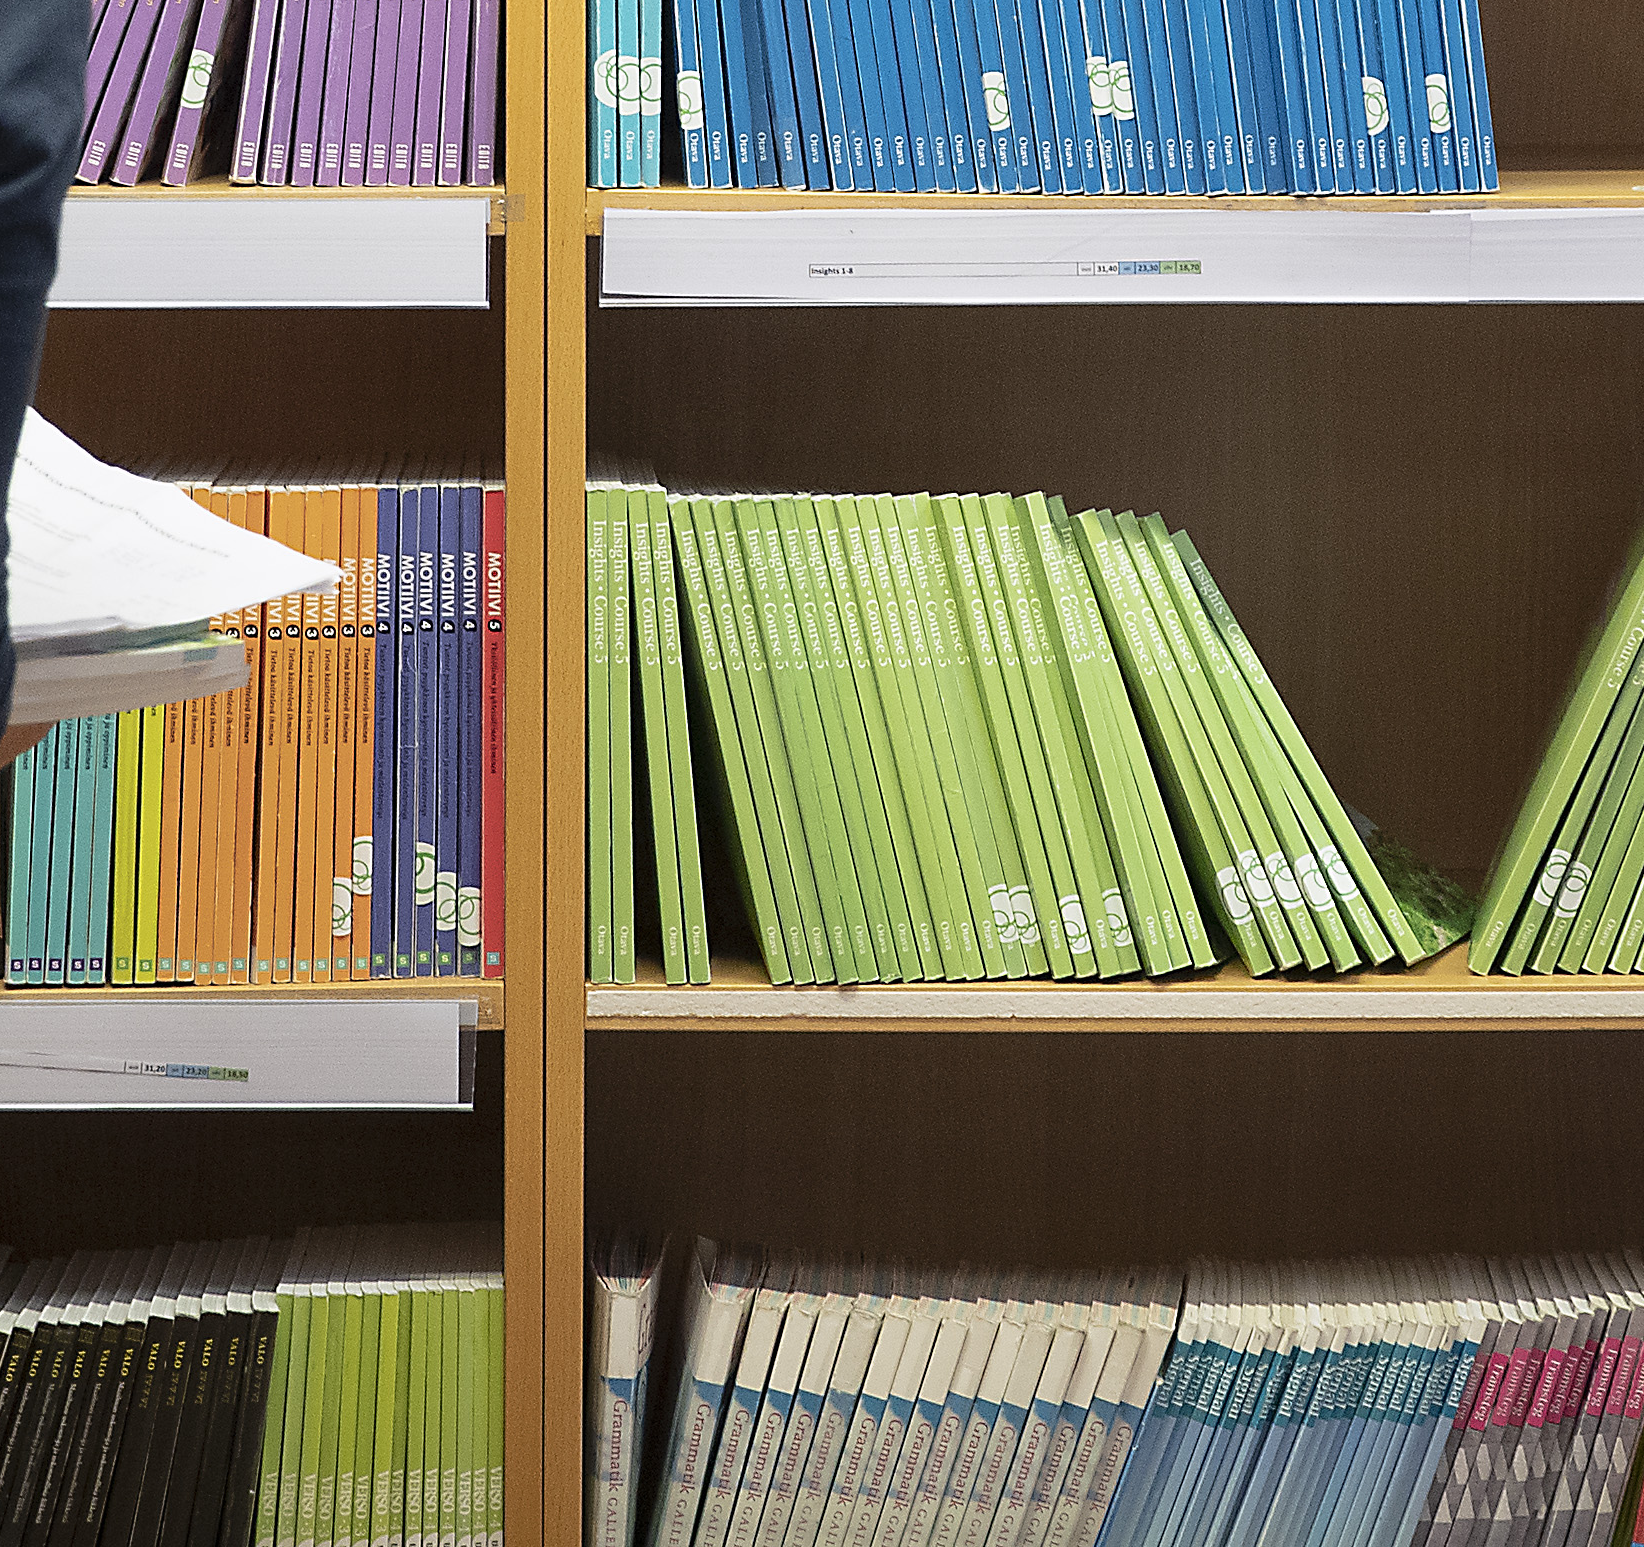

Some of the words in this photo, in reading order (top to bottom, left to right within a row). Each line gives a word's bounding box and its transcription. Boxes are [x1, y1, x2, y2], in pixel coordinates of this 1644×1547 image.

[1398, 136, 1406, 166] Otava
[1461, 137, 1469, 167] Otava
[811, 266, 840, 275] Insights
[1097, 264, 1117, 273] 31,40
[1138, 264, 1159, 272] 23,30
[1179, 263, 1200, 272] 18,70
[590, 521, 607, 582] Insights
[342, 557, 356, 621] MOTIIVI
[419, 552, 433, 616] MOTIIVI
[488, 552, 502, 616] MOTIIVI
[343, 626, 355, 635] 3
[421, 621, 431, 630] 4
[489, 622, 501, 630] 5
[594, 595, 607, 649] Course
[596, 654, 608, 663] 5
[144, 1065, 165, 1073] 31,20
[186, 1068, 207, 1076] 23,20
[121, 1348, 133, 1377] VALO
[1363, 1355, 1388, 1408] Signal
[1474, 1364, 1504, 1422] Framsteg
[609, 1399, 627, 1492] Grammatik
[340, 1472, 353, 1516] VERSO
[489, 1466, 502, 1511] VERSO
[606, 1497, 618, 1547] GALLE
